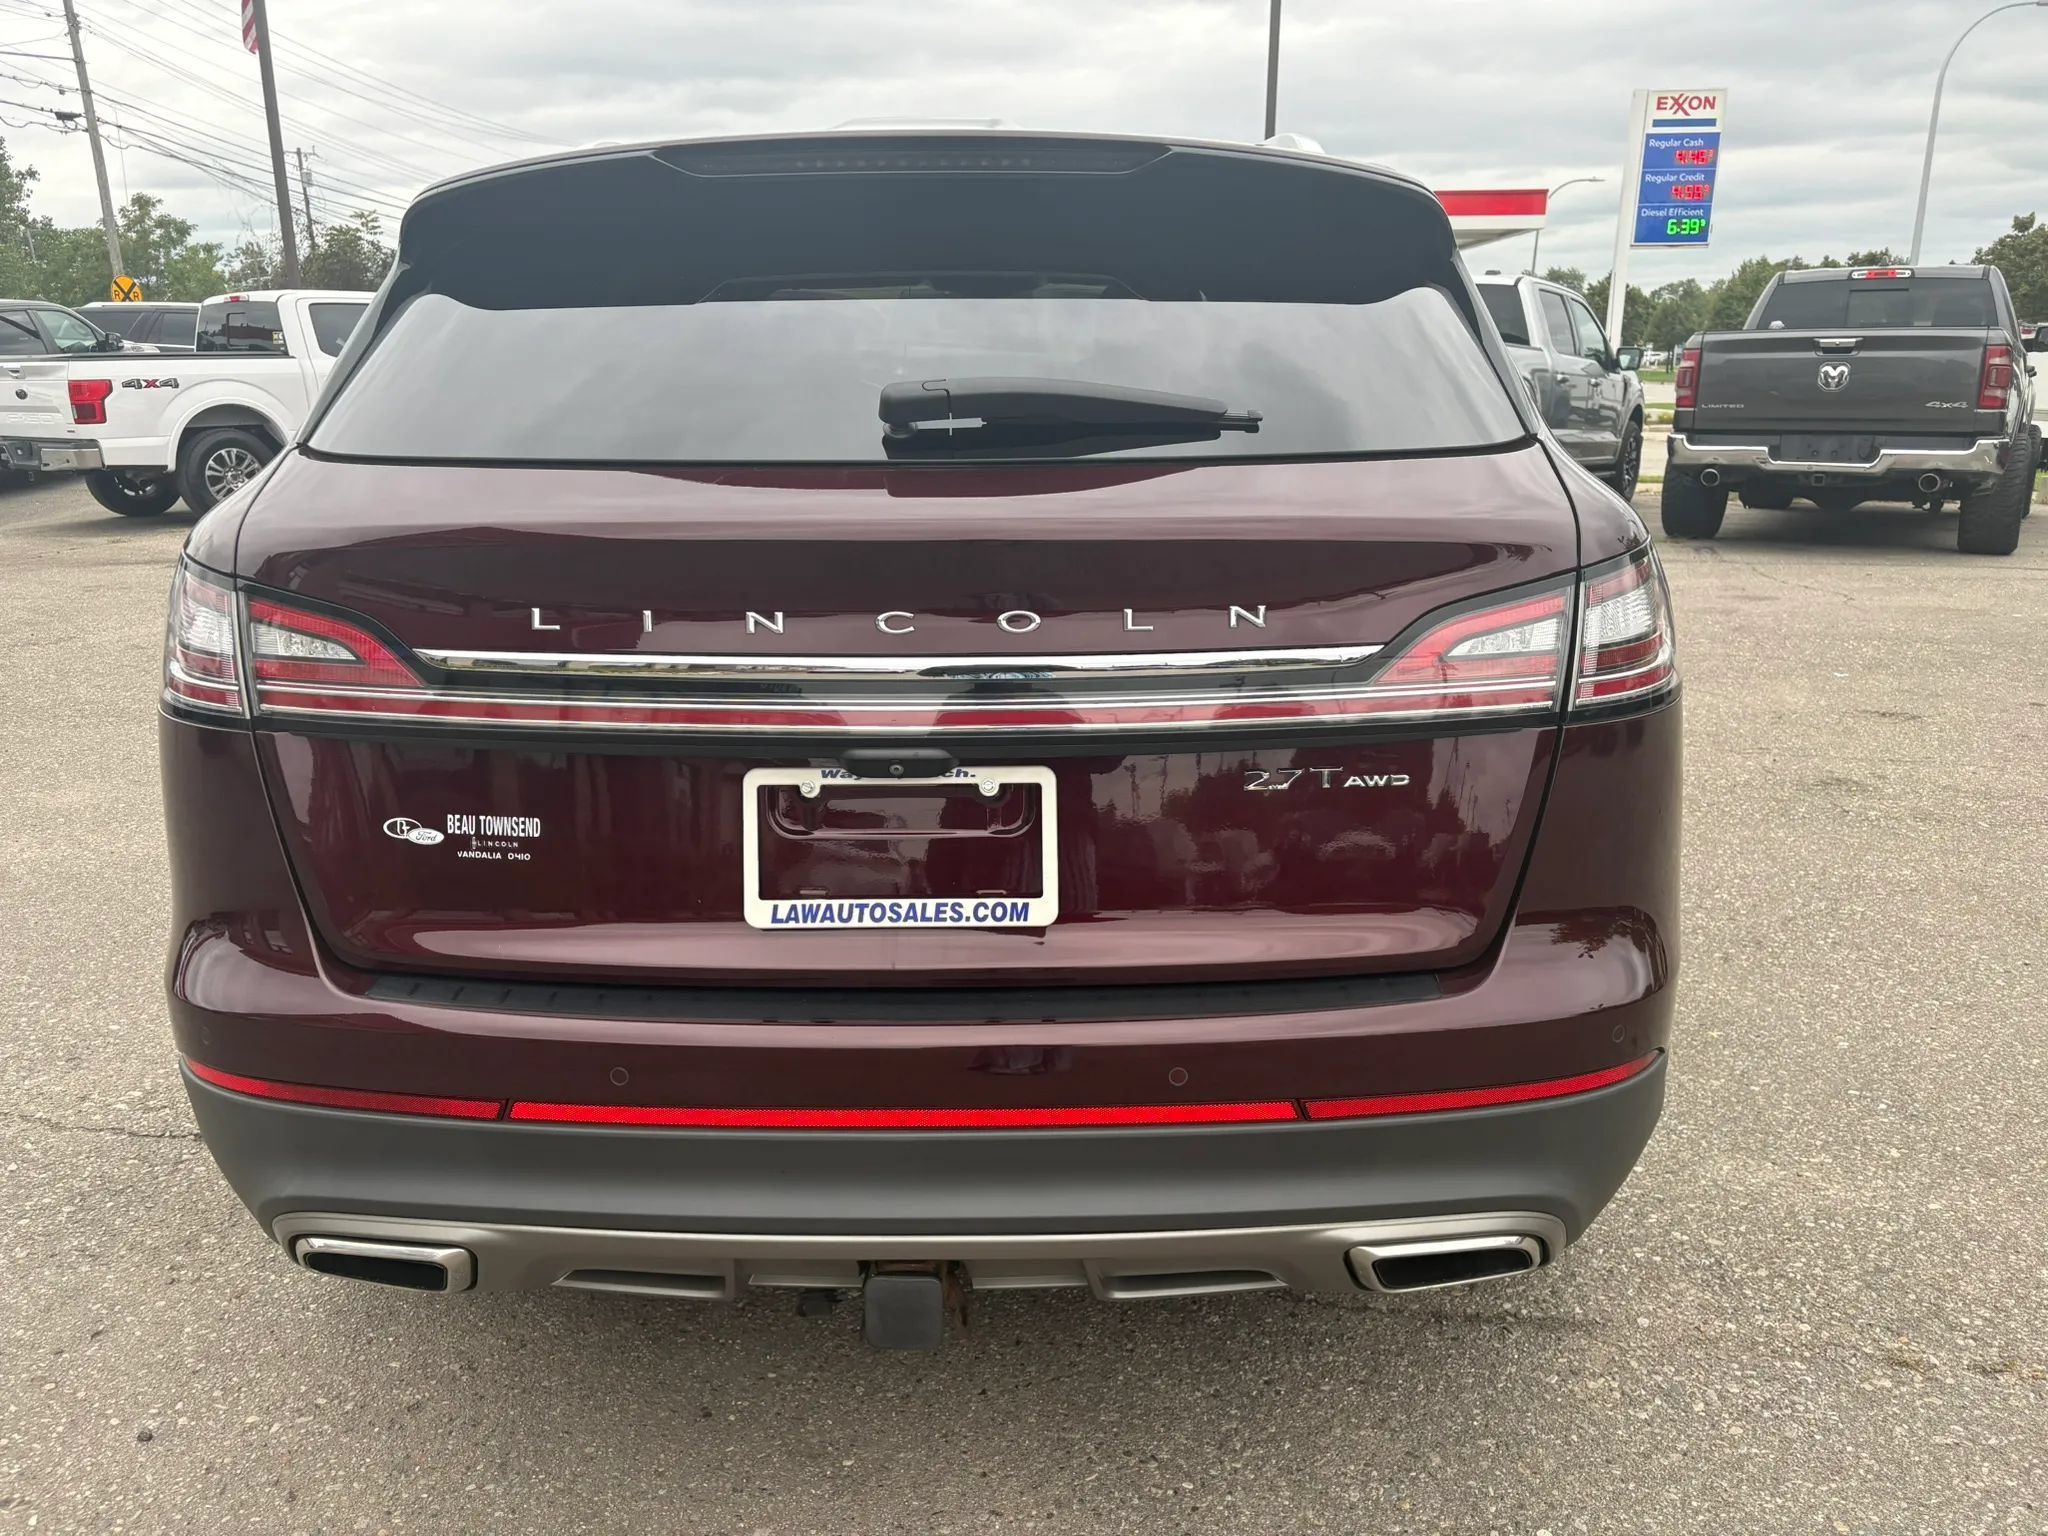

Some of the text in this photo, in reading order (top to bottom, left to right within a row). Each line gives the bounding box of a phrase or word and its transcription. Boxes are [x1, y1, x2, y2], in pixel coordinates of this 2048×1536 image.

[1649, 138, 1704, 149] Regular Cash
[1645, 173, 1705, 184] Regular Credit
[1641, 207, 1704, 217] Diesel Efficient
[114, 290, 140, 300] R R
[530, 604, 1267, 636] LINCOLN
[1343, 774, 1410, 788] AWD
[447, 813, 541, 838] BEAU TOWNSEND
[415, 830, 438, 842] Ford
[477, 840, 519, 848] LINCOLN
[457, 850, 502, 860] VANDALIA
[770, 901, 1030, 925] LAWAUTOSALES.COM
